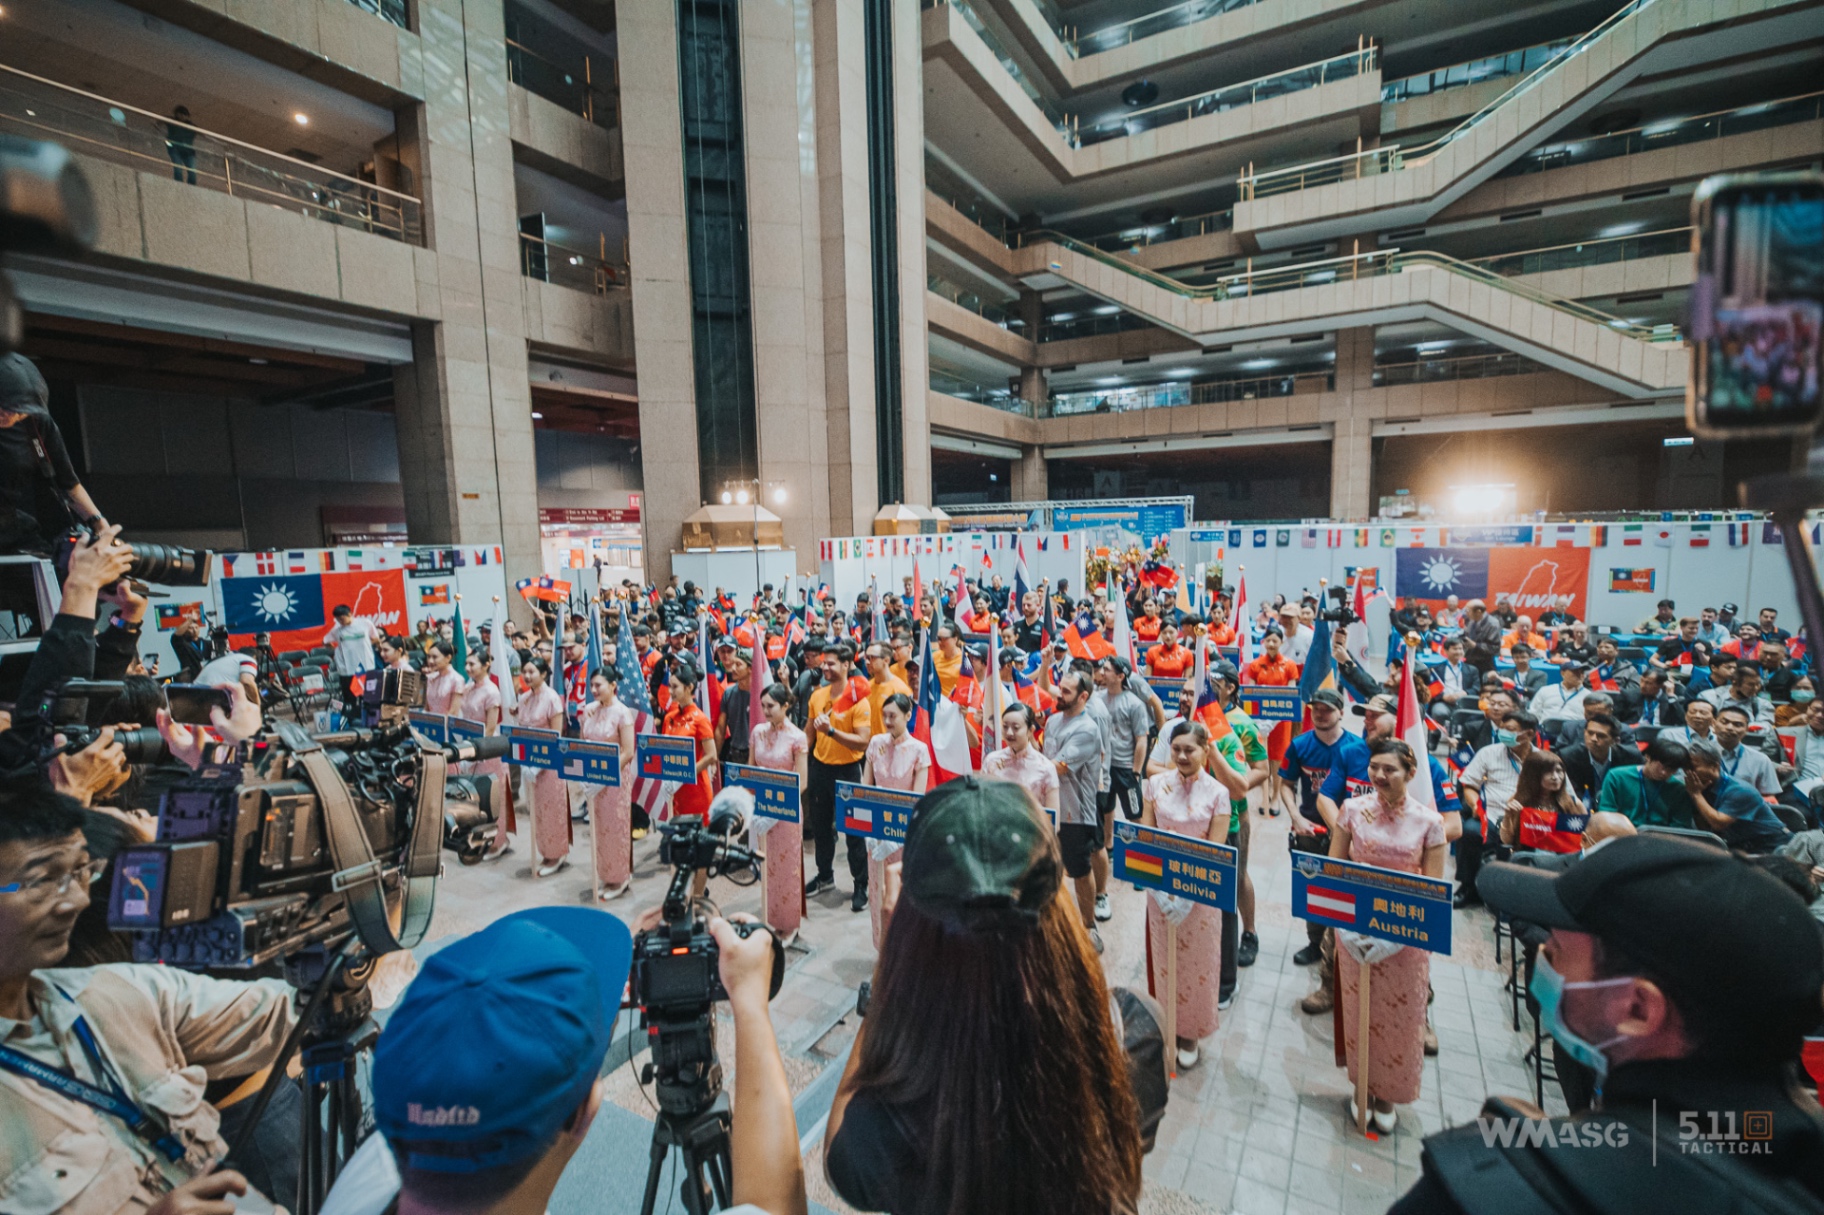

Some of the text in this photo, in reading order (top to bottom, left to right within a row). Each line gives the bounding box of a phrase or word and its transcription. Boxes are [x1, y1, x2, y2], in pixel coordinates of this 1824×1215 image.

[1262, 710, 1294, 718] Romania
[530, 756, 551, 765] France
[663, 754, 689, 766] 中華民國
[757, 802, 797, 817] The Netherlands
[1168, 859, 1222, 885] 玻利維亞
[1172, 878, 1217, 900] Bolivia
[1373, 898, 1425, 922] 奧地利
[1368, 917, 1429, 942] Austria
